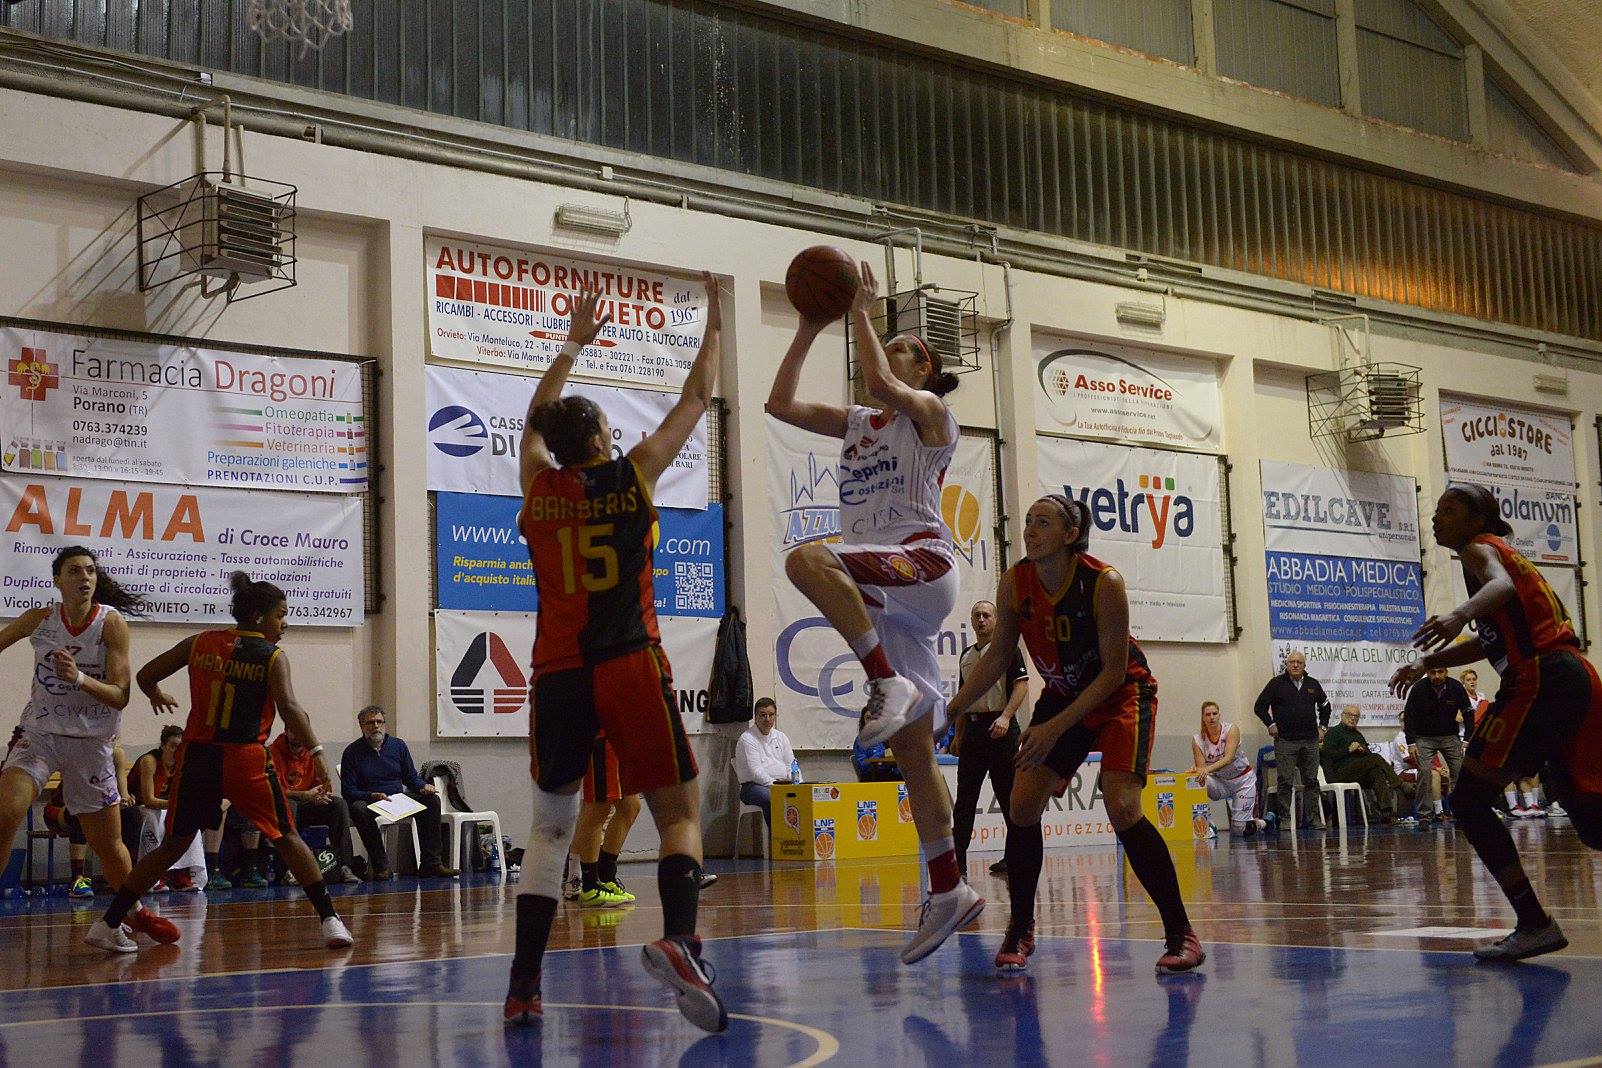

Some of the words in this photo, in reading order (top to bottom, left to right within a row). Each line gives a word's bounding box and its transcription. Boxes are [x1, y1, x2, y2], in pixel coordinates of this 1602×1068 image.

[436, 246, 664, 304] AUTOFORNITURE
[673, 291, 691, 304] dal
[551, 292, 666, 330] OVIETO
[670, 306, 699, 326] 1967
[436, 301, 474, 318] RICAMBI
[483, 308, 533, 326] ACCESSORI
[542, 316, 570, 331] LUBRIF
[602, 325, 617, 338] PER
[619, 328, 643, 341] AUTO
[646, 331, 651, 342] E
[652, 332, 700, 349] AUTOCARRI
[437, 328, 467, 340] Orvieto:
[468, 332, 480, 342] Via
[482, 334, 523, 349] Monteluco,
[525, 339, 534, 349] 22
[542, 342, 552, 352] Tel.
[610, 351, 634, 362] 302221
[642, 356, 654, 365] Fax
[477, 346, 506, 358] Viterbo:
[507, 350, 519, 360] Via
[521, 352, 545, 363] Monte
[586, 360, 598, 370] Tel.
[606, 362, 618, 373] Fax
[620, 363, 665, 378] 0761.228190
[71, 348, 202, 388] Farmacia
[214, 360, 337, 403] Dragoni
[73, 384, 88, 395] Via
[92, 387, 139, 400] Marconi,
[142, 391, 148, 400] 5
[1074, 374, 1116, 393] Asso
[1119, 378, 1173, 401] Service
[73, 396, 126, 414] Porano
[128, 405, 148, 417] (TR)
[264, 406, 334, 423] Omeopatia
[72, 420, 148, 436] 0763.374239
[265, 422, 335, 439] Fitoterapia
[489, 415, 524, 431] CASS
[72, 435, 148, 449] nadrago@tin.it
[490, 432, 517, 458] DI
[1461, 415, 1498, 443] CICCI
[1507, 417, 1553, 455] STORE
[266, 438, 335, 454] Veterinaria
[1490, 443, 1504, 457] dal
[207, 450, 280, 467] Preparazioni
[282, 455, 337, 470] galeniche
[678, 452, 702, 461] OLARE
[207, 469, 298, 484] PRENOTAZIONI
[303, 474, 338, 486] C.U.P.
[5, 483, 206, 543] ALMA
[530, 485, 638, 521] BARBERIS
[1263, 490, 1392, 530] EDILCAVE
[1491, 486, 1572, 523] olanum
[782, 508, 842, 545] AZZU
[218, 528, 234, 544] di
[240, 529, 289, 548] Croce
[295, 532, 349, 550] Mauro
[126, 548, 208, 563] Assicurazione
[221, 552, 251, 565] Tasse
[254, 555, 344, 568] automobilistiche
[453, 555, 507, 570] Risparmia
[509, 558, 533, 570] anch
[556, 522, 619, 595] 15
[138, 565, 148, 576] di
[152, 566, 207, 579] proprietà
[219, 569, 311, 582] Imtricolazioni
[453, 571, 510, 586] d'acquisto
[512, 573, 537, 586] italia
[1267, 555, 1348, 583] ABBADIA
[1352, 560, 1419, 586] MEDICA
[3, 575, 55, 590] Duplica
[125, 582, 155, 592] carte
[159, 582, 170, 593] di
[174, 583, 233, 596] circolazio
[312, 588, 352, 600] gratuiti
[1267, 582, 1301, 595] STUDIO
[1306, 585, 1341, 596] MEDICO
[1345, 586, 1420, 600] POLISPECIALISTICO
[3, 596, 42, 608] Vicolo
[136, 600, 190, 614] ORVIETO
[202, 603, 216, 615] TR
[288, 606, 353, 619] 763.342967
[1303, 646, 1359, 663] FARMACIA
[1363, 648, 1383, 663] DEL
[1385, 649, 1418, 664] MORO
[193, 652, 266, 682] MADONNA
[205, 680, 237, 730] 11
[856, 800, 877, 809] LNP
[1157, 792, 1173, 800] LNP
[814, 818, 835, 827] LNP
